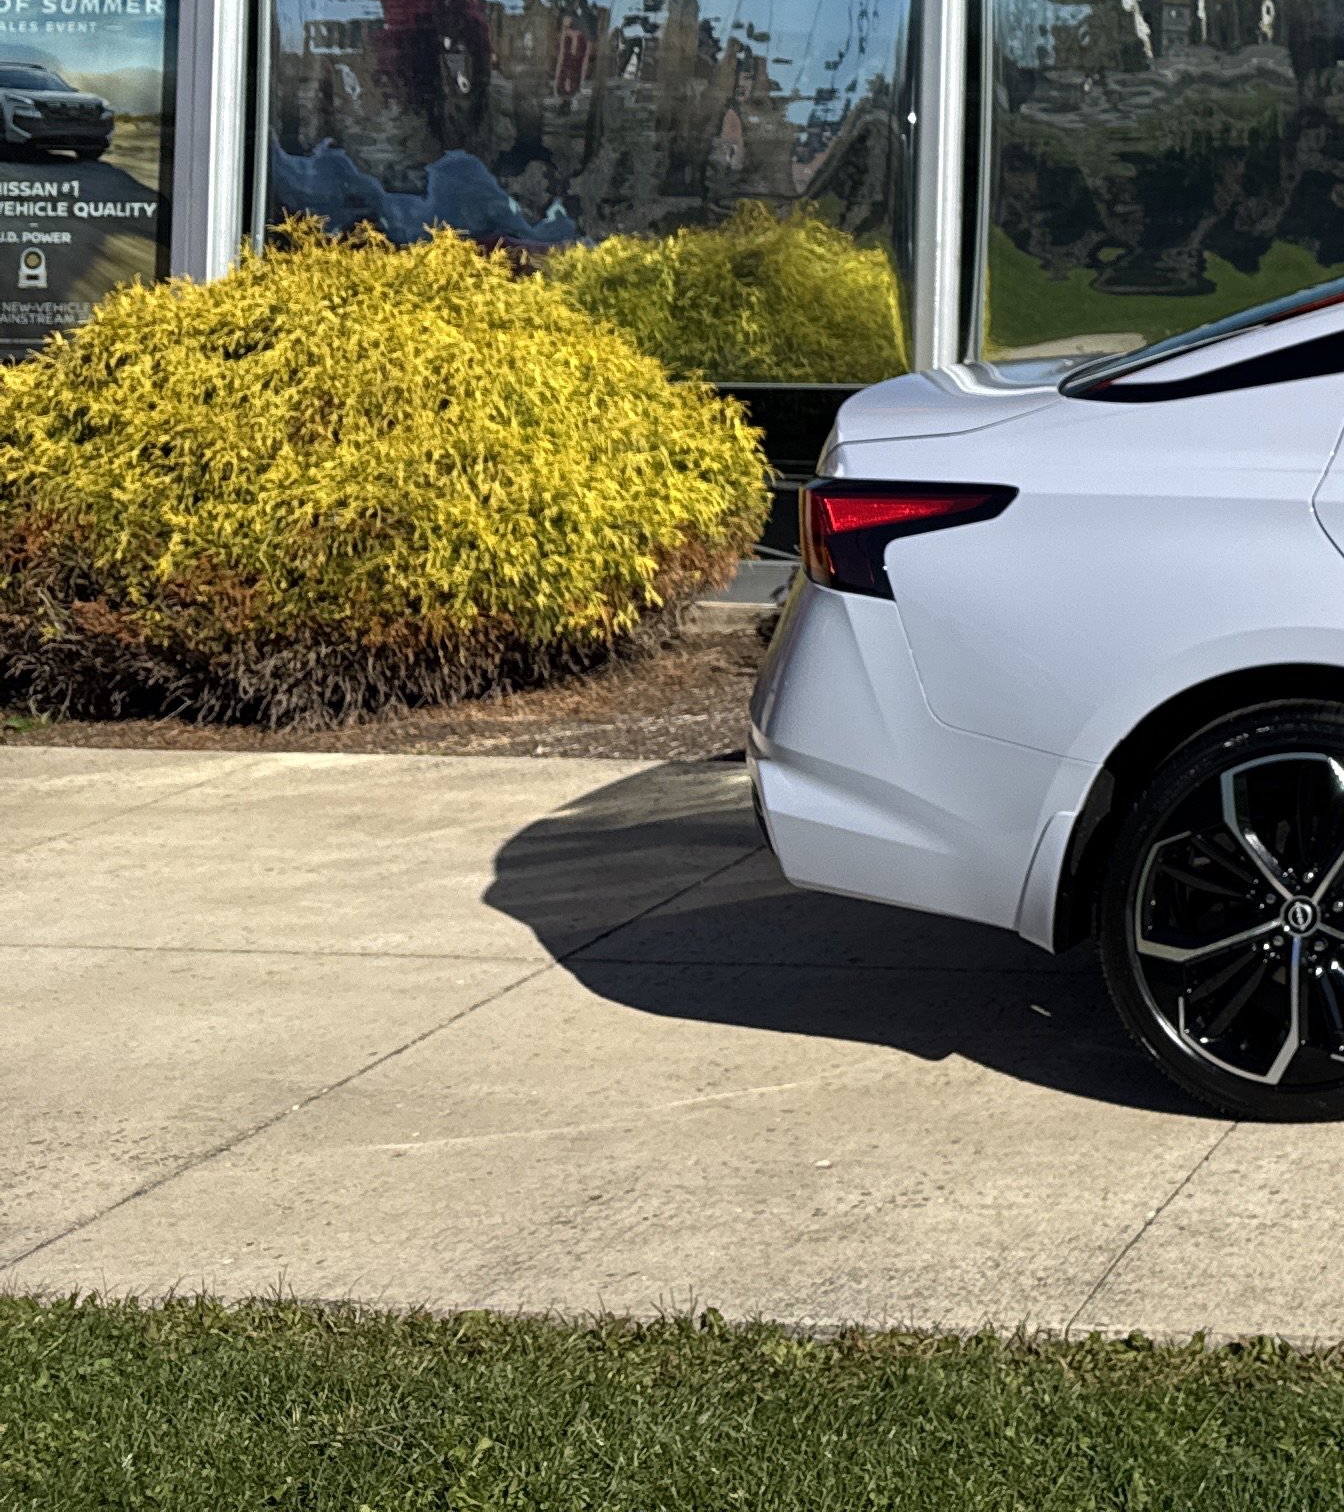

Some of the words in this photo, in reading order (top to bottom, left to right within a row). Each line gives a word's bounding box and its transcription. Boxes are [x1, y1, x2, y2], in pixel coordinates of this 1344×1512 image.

[45, 21, 97, 33] EVENT
[0, 180, 58, 197] ISSAN
[73, 202, 158, 218] QUALITY
[22, 231, 72, 244] POWER
